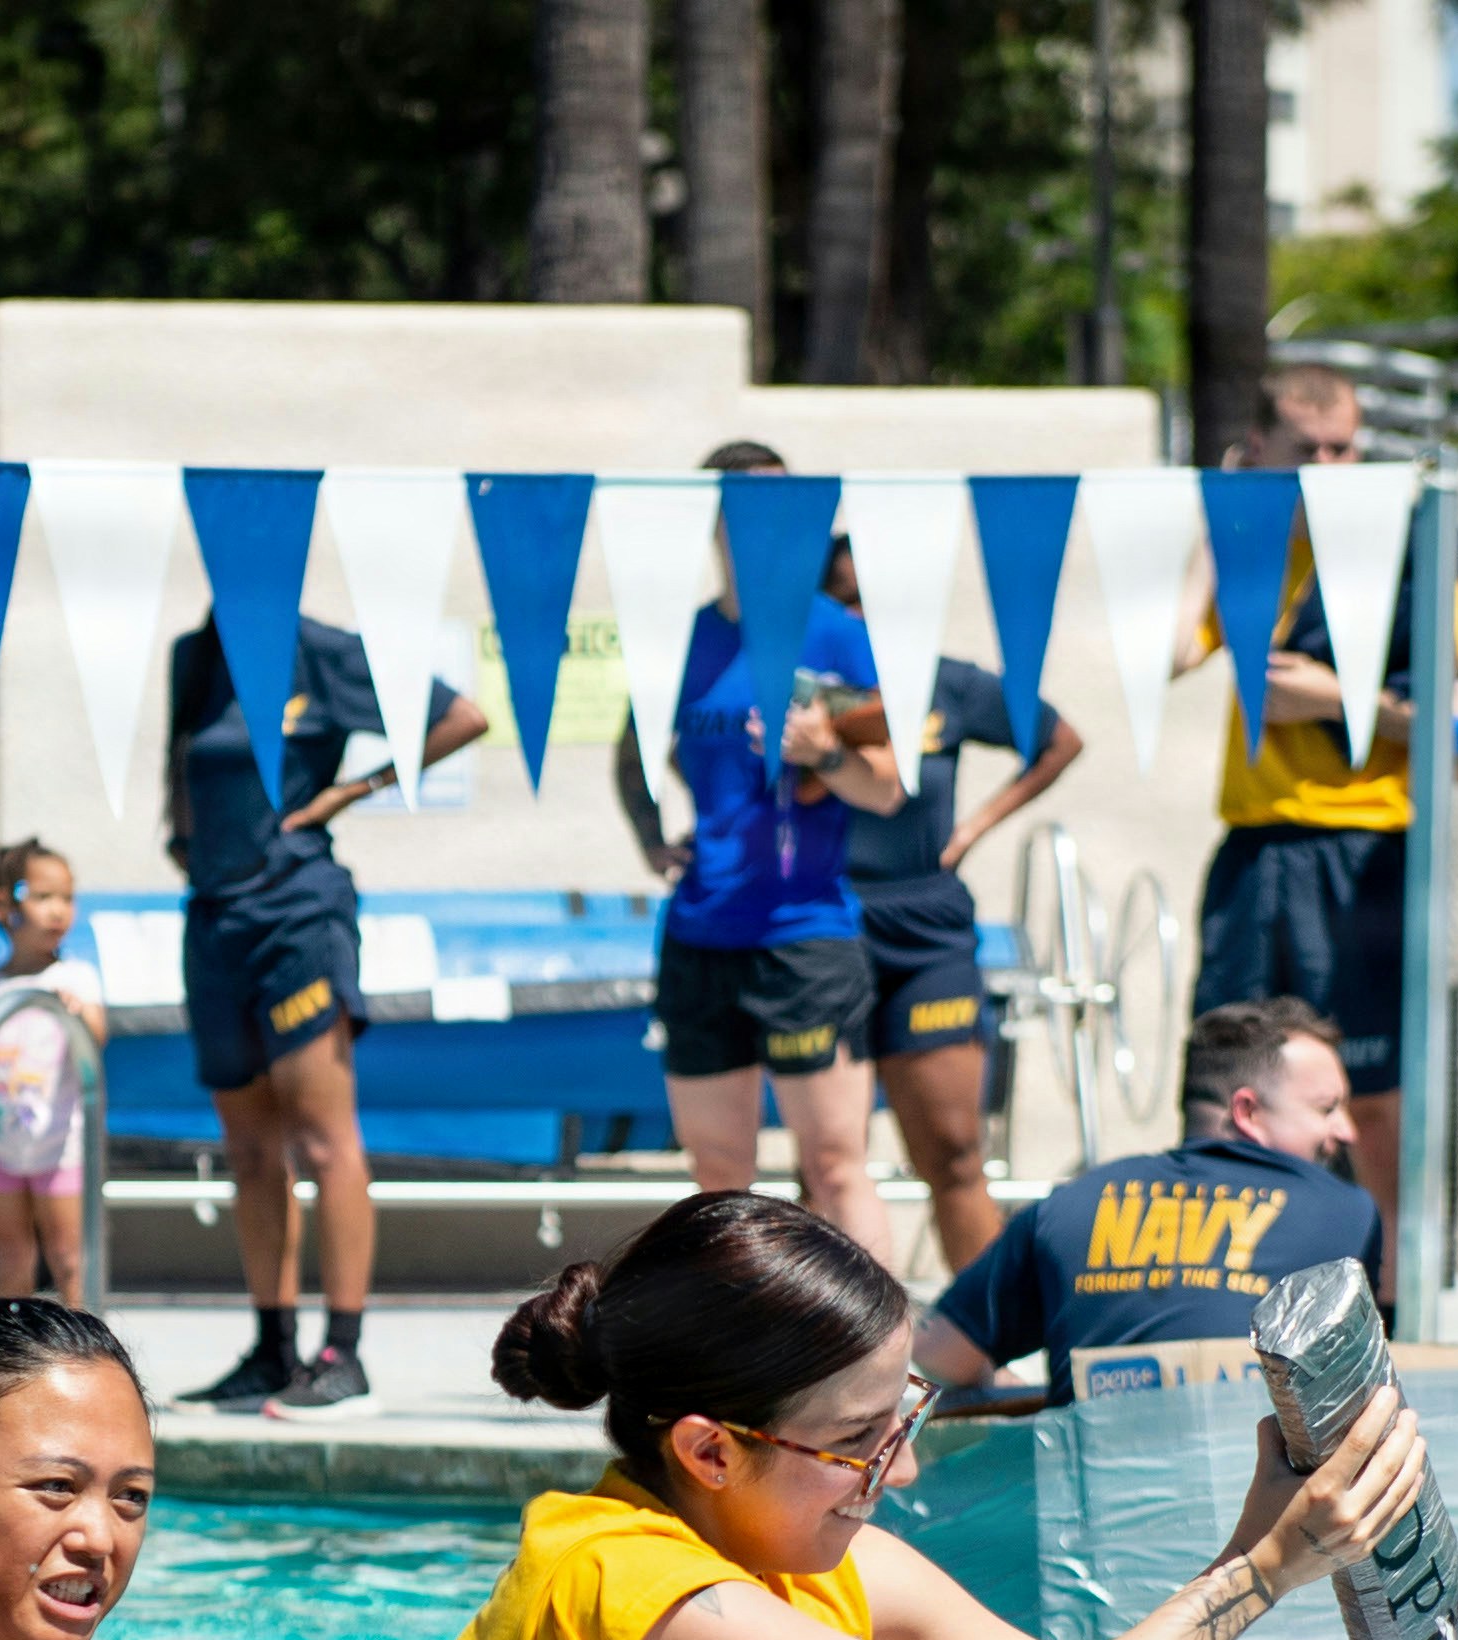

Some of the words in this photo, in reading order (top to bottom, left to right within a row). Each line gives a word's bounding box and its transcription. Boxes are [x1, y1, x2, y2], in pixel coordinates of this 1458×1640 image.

[1087, 1197, 1281, 1270] NAVY
[1075, 1270, 1142, 1294] FORGED
[1147, 1268, 1174, 1290] BY
[1181, 1267, 1222, 1290] THE
[1227, 1272, 1270, 1296] SEA
